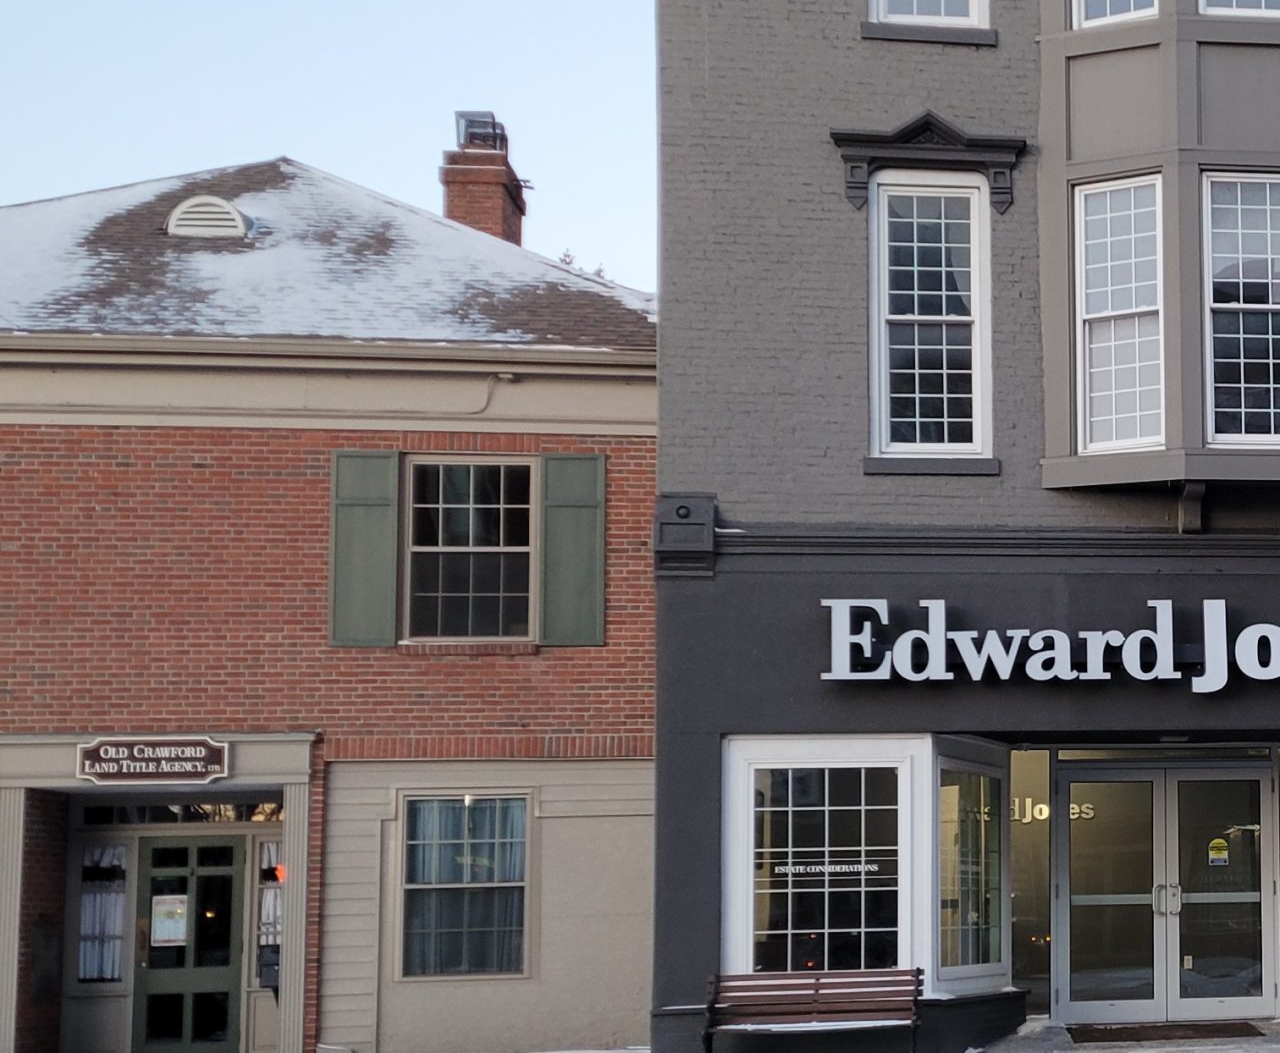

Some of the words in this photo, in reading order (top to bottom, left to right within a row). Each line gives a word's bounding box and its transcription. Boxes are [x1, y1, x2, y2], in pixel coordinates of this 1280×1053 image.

[820, 598, 1182, 682] Edward
[100, 745, 128, 759] OLD
[133, 745, 205, 758] CRAWFORD
[84, 760, 118, 773] LAND
[120, 760, 157, 773] TITLE
[774, 865, 806, 874] ESTATE
